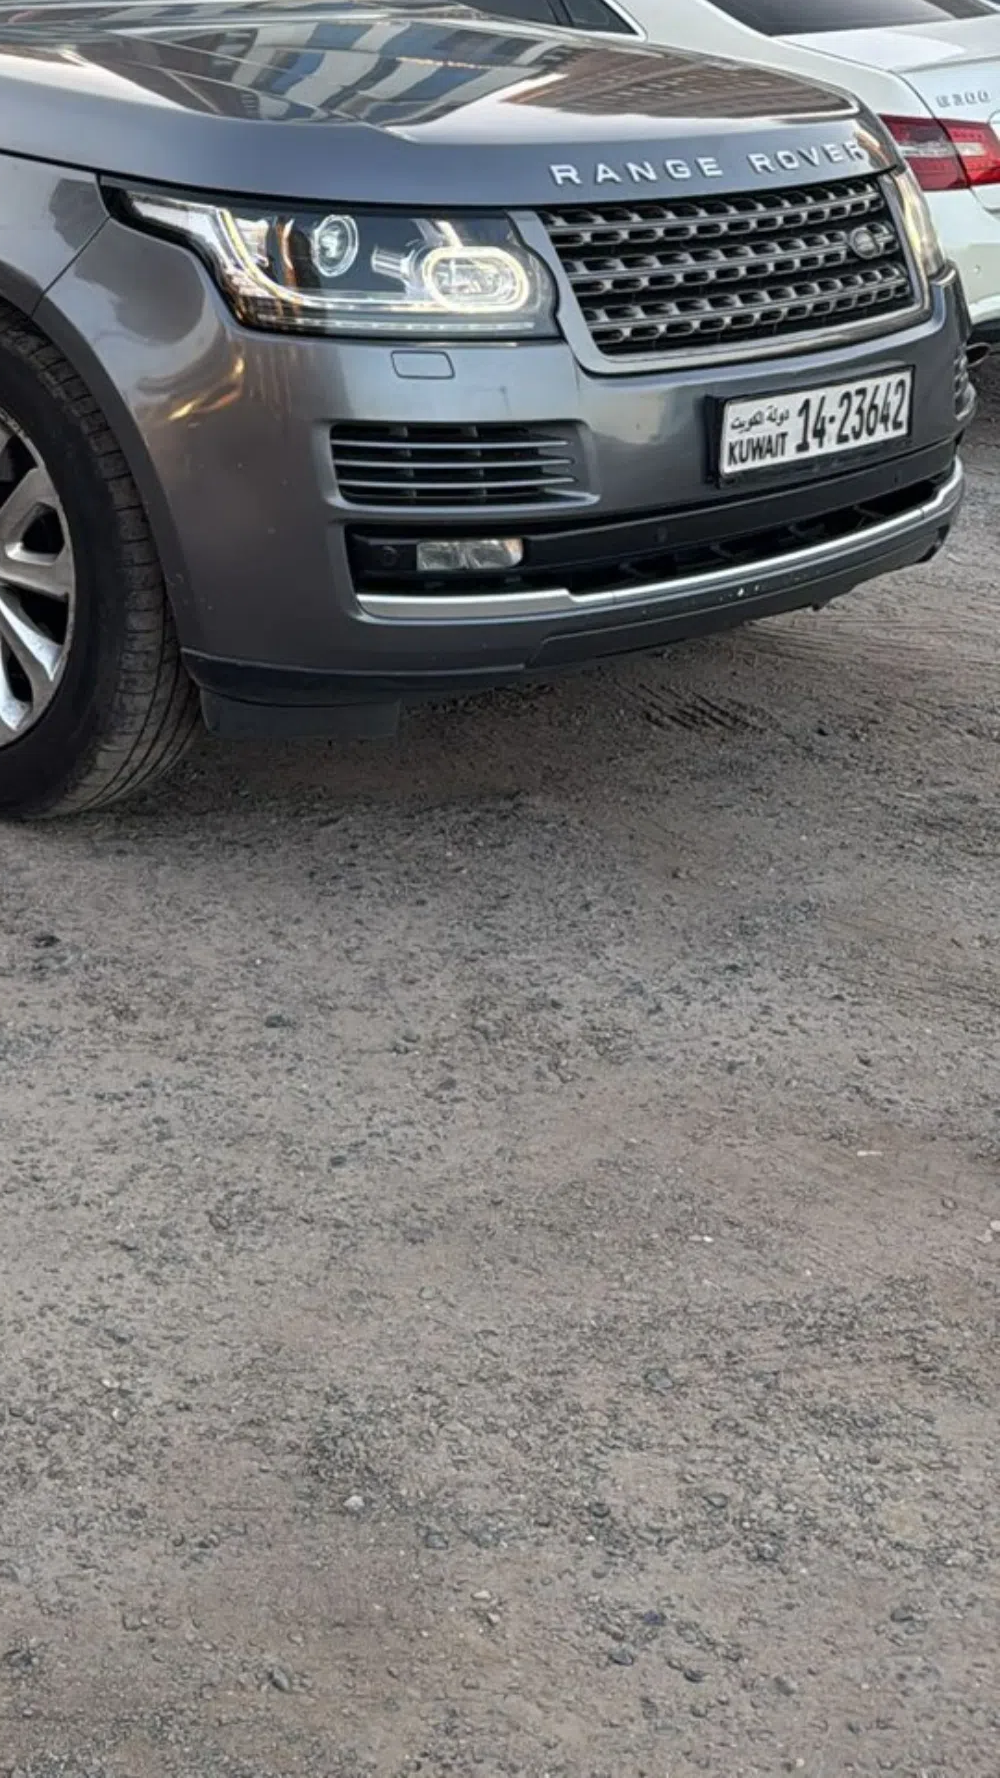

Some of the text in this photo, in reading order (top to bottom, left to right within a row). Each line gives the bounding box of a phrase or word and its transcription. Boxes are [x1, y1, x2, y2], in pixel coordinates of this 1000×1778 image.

[551, 139, 868, 187] RANGE ROVER
[766, 405, 790, 426] دولة
[727, 432, 788, 466] KUWAIT
